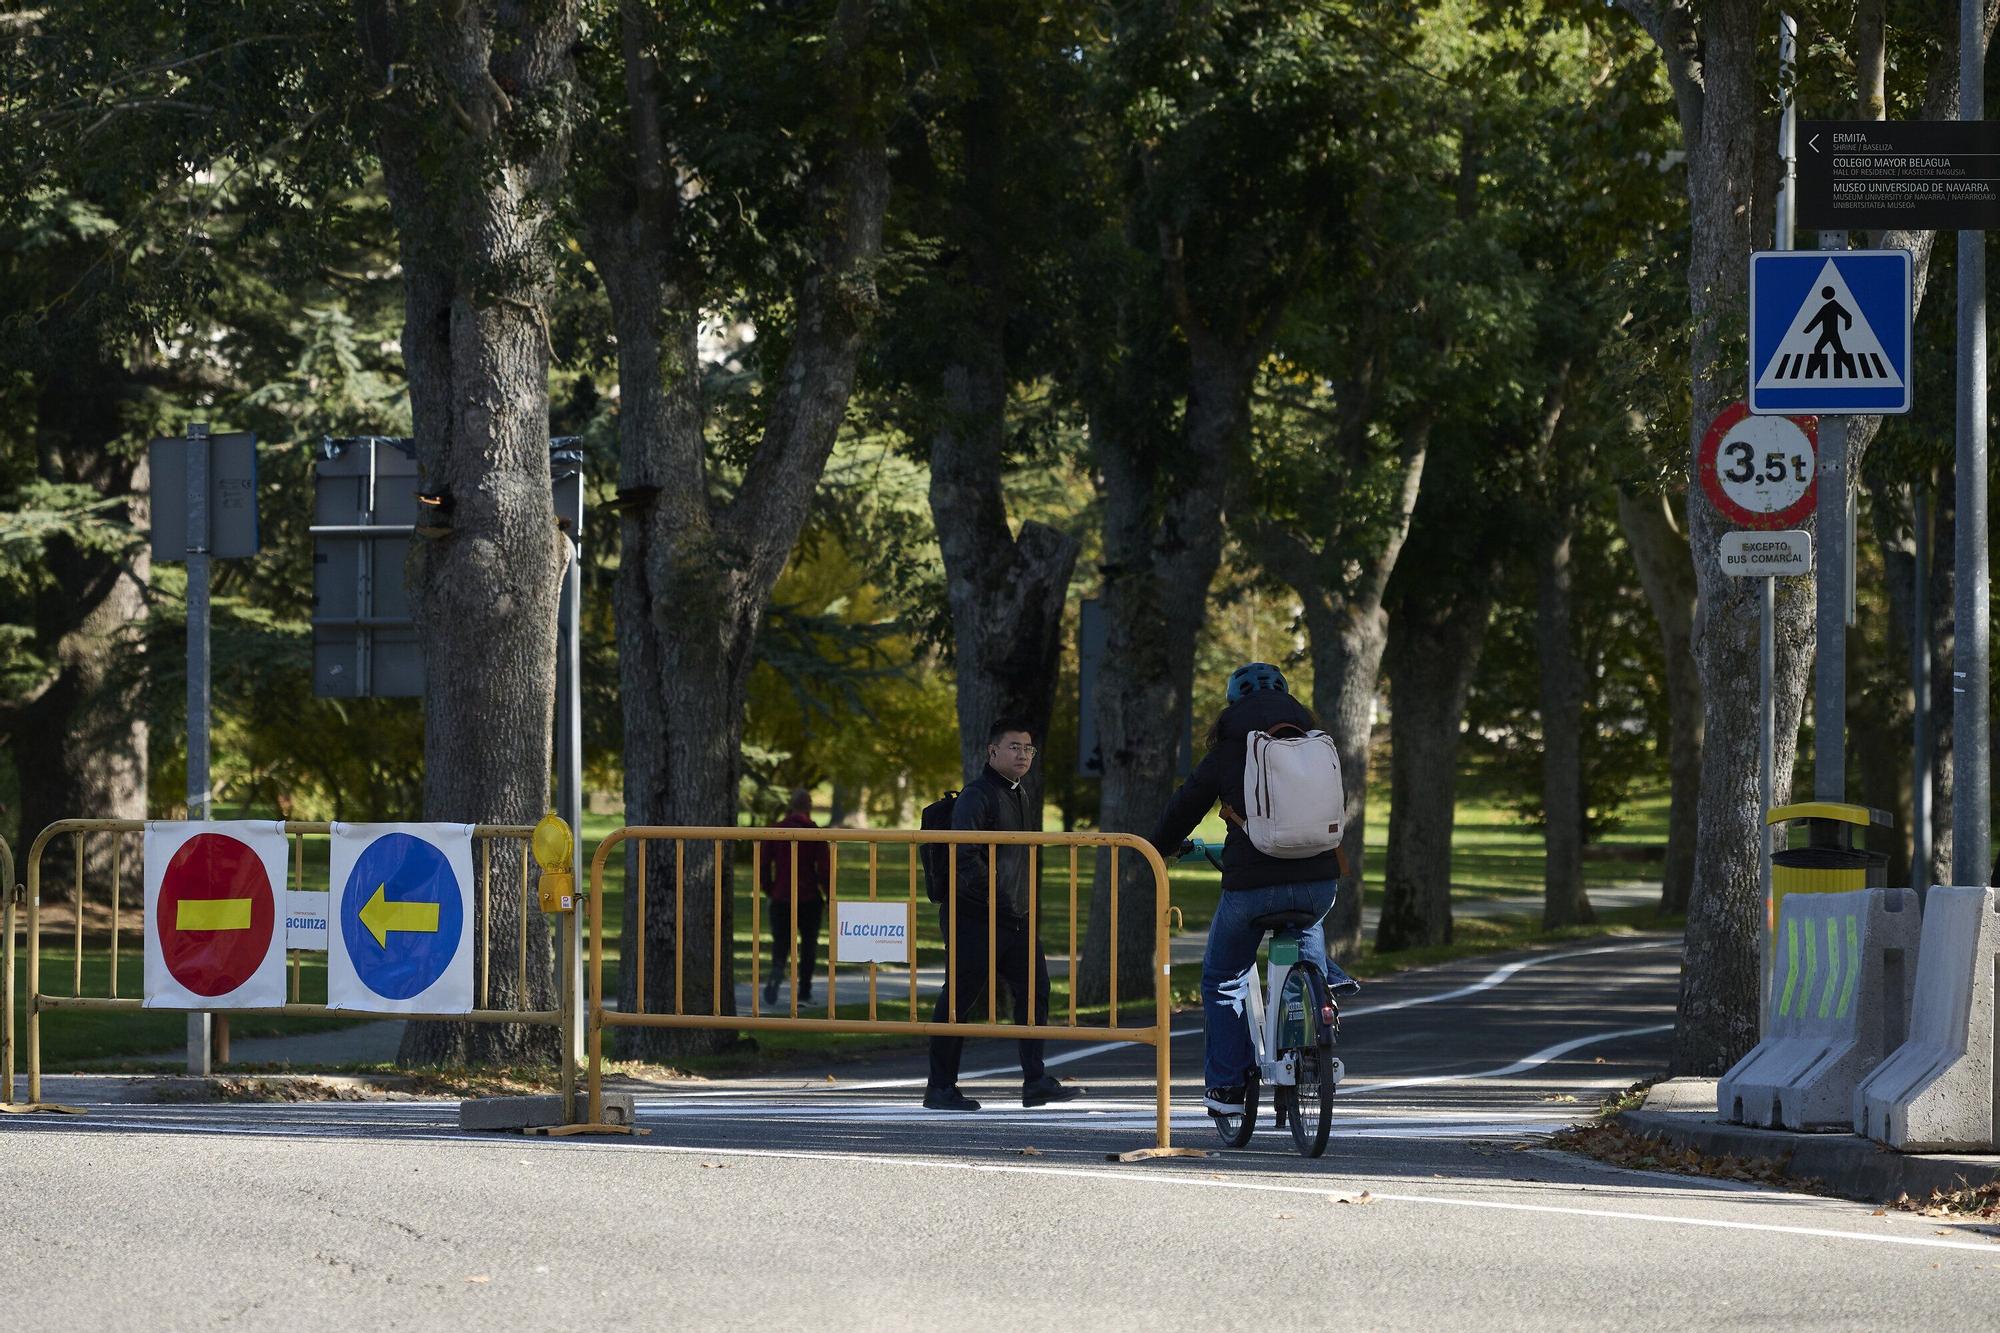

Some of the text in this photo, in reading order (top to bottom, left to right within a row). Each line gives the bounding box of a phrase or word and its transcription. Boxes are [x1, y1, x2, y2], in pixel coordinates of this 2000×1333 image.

[1833, 133, 1867, 142] ERMITA
[1833, 158, 1951, 168] COLEGIO MAYOR BELAGUA
[1833, 183, 1990, 192] MUSEO UNIVERSIDAD DE NAVARRA
[1741, 542, 1788, 552] EXCEPTO
[1727, 553, 1802, 564] BUS COMARCAL
[286, 917, 326, 930] acunza
